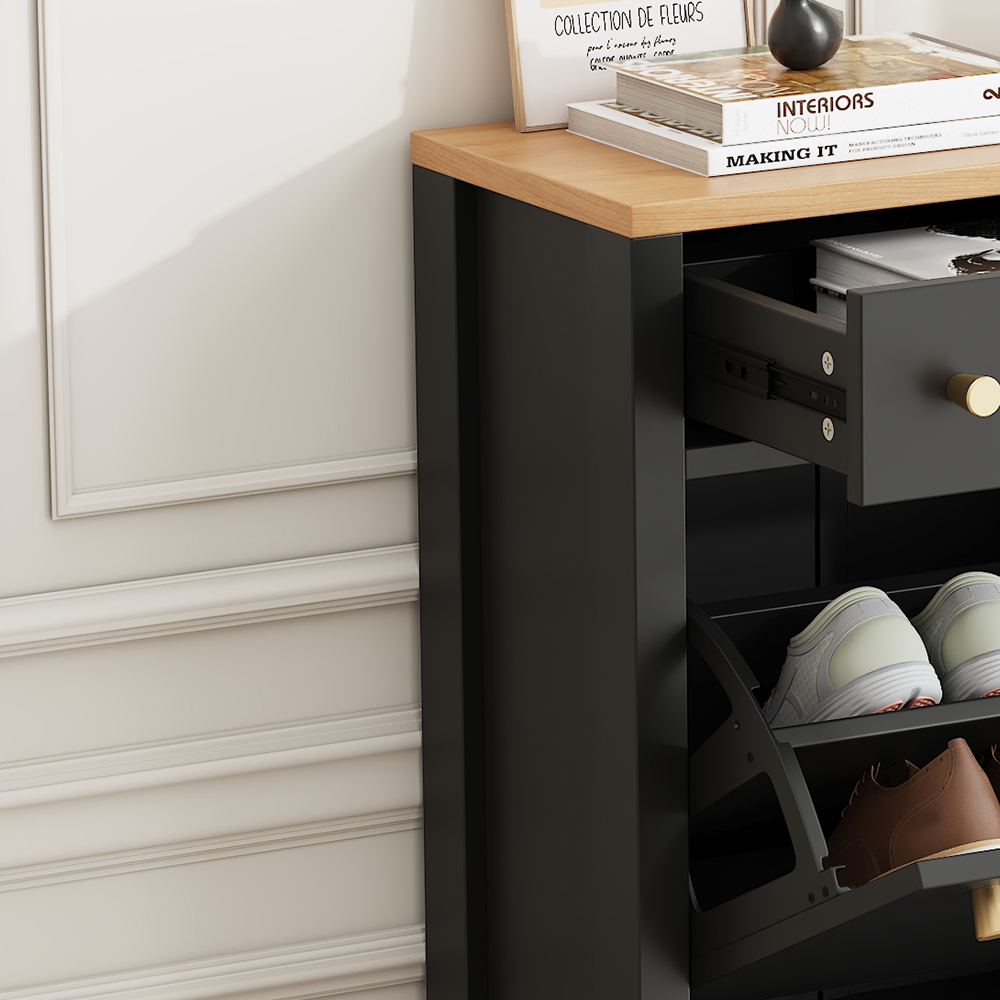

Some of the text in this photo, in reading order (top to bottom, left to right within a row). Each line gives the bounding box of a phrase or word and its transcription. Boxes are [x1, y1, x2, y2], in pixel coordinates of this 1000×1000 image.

[554, 1, 704, 36] COLLECTION DE FLEURS
[777, 92, 874, 118] INTERIORS
[777, 114, 831, 135] NOW!
[848, 133, 942, 147] MANUFACTURING TECHNIQUES
[726, 145, 838, 168] MAKING IT
